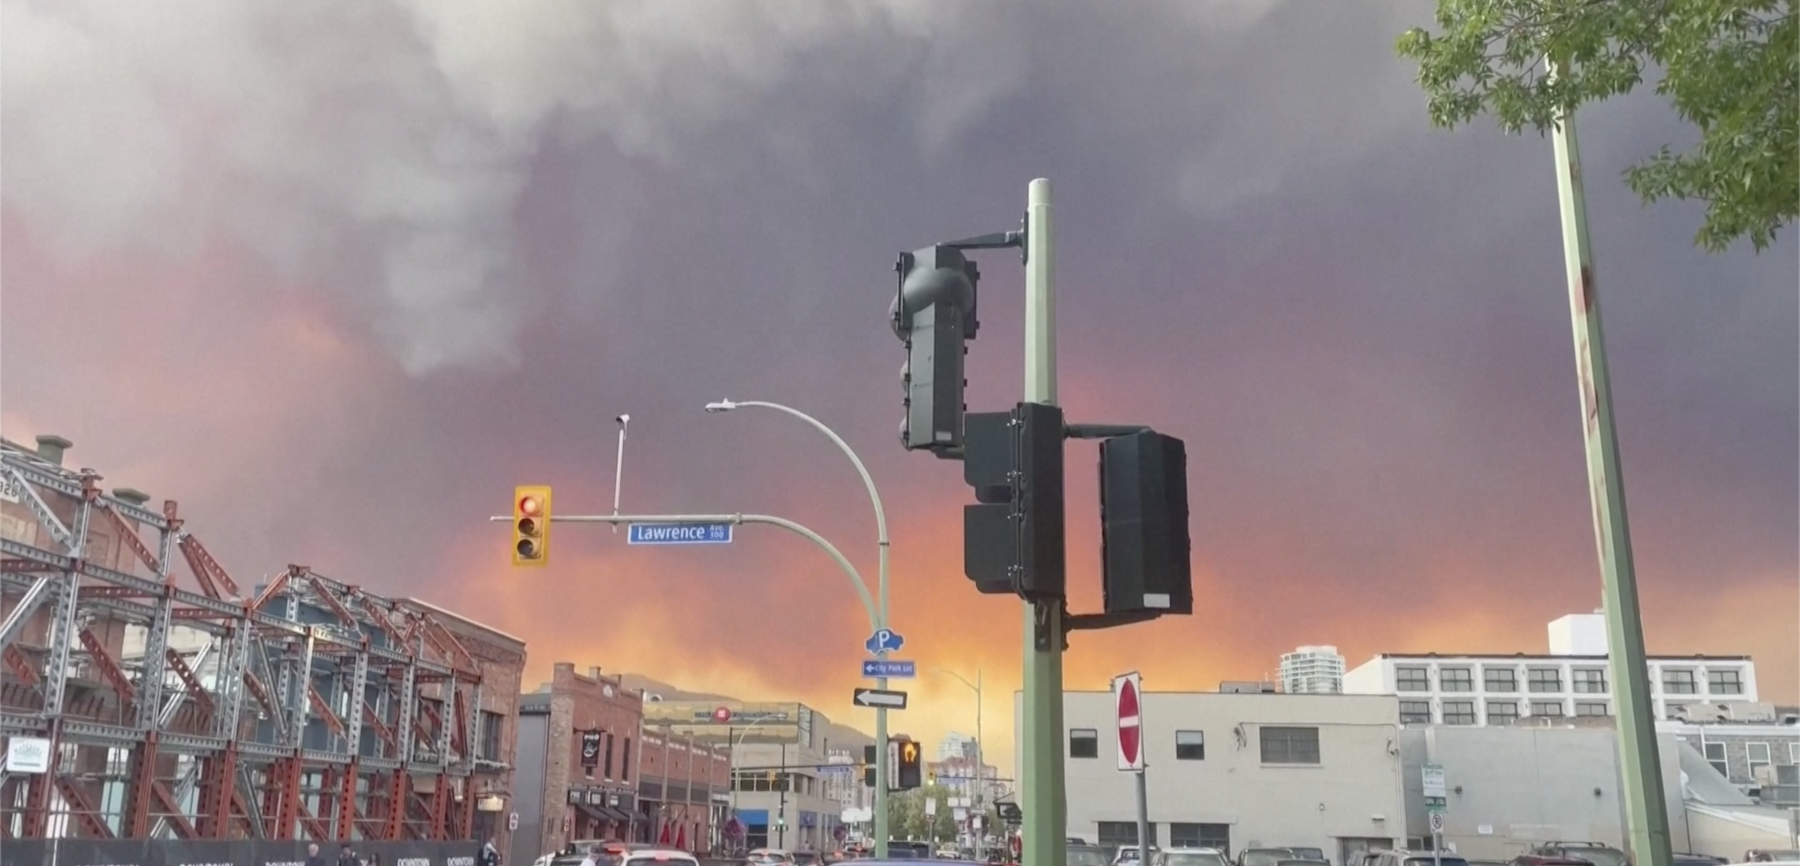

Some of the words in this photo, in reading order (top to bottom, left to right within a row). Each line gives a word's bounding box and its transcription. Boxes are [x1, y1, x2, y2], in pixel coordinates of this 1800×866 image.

[638, 526, 705, 541] Lawrence
[878, 630, 891, 649] P
[875, 665, 887, 673] City
